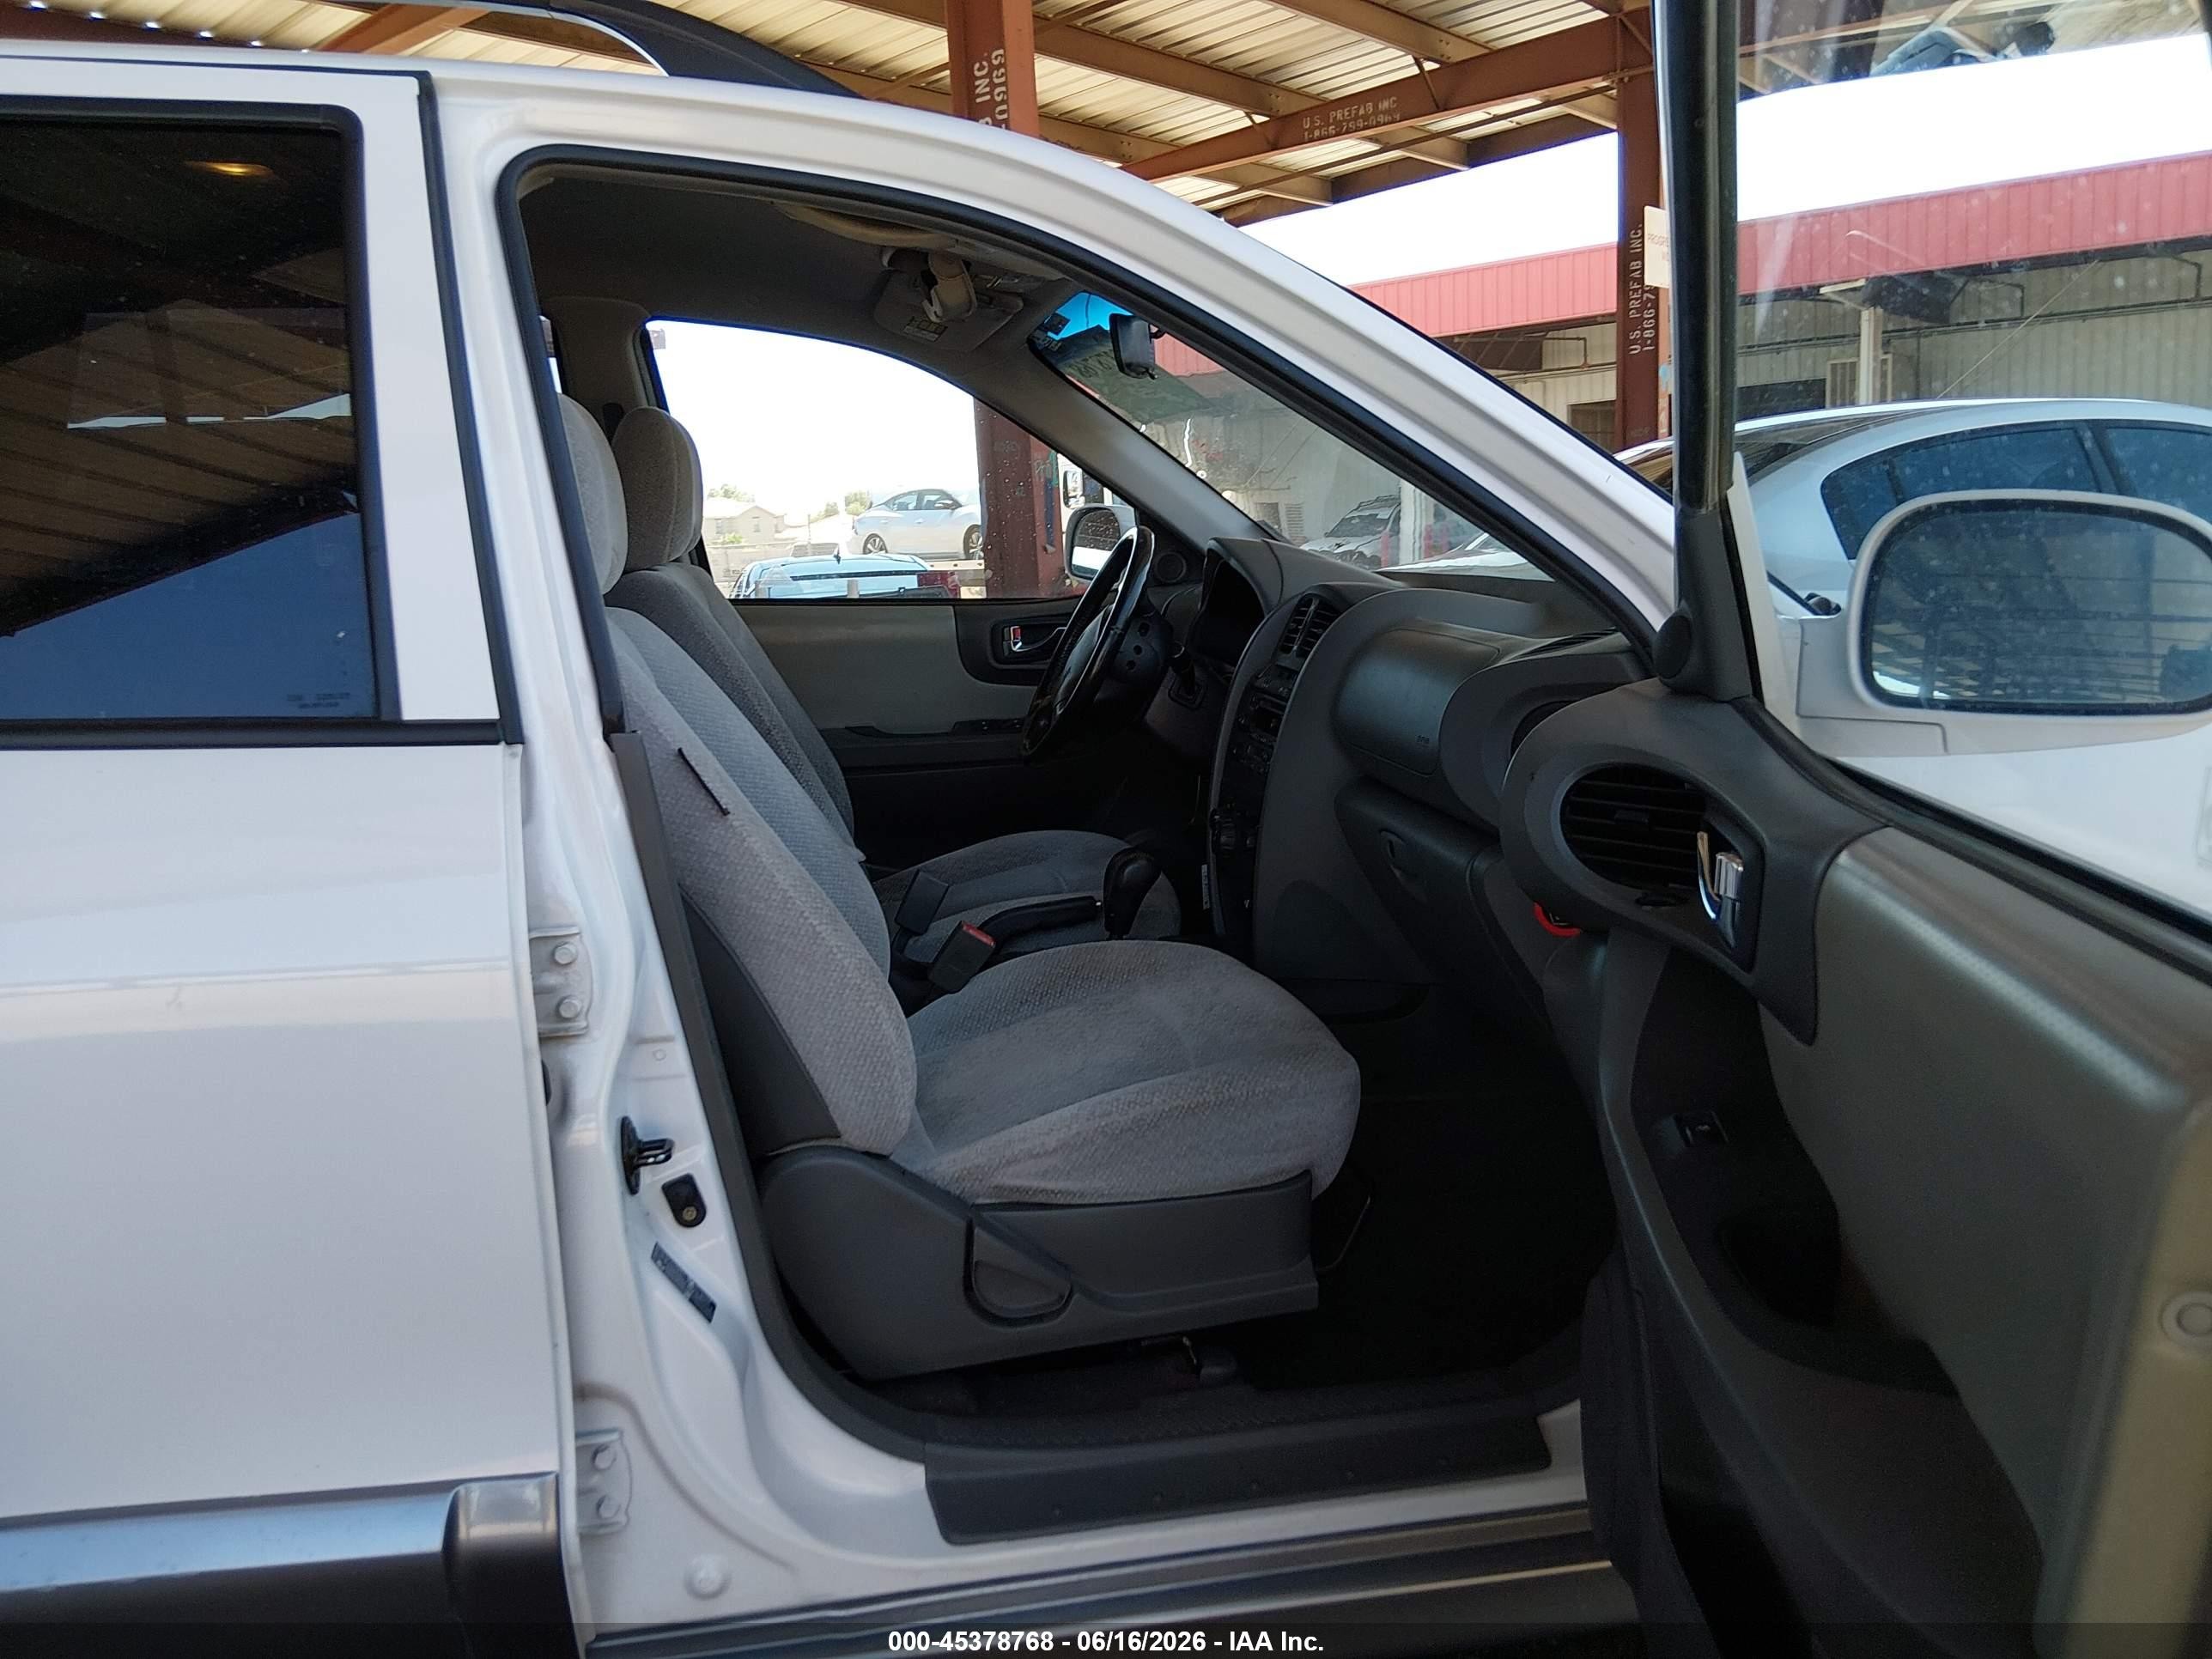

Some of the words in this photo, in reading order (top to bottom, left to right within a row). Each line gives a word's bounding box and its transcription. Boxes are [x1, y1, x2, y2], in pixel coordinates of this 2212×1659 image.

[1329, 102, 1373, 123] PREFAB
[1629, 223, 1644, 253] INC.
[1629, 260, 1643, 319] PREFAB
[1629, 325, 1642, 355] U.S.
